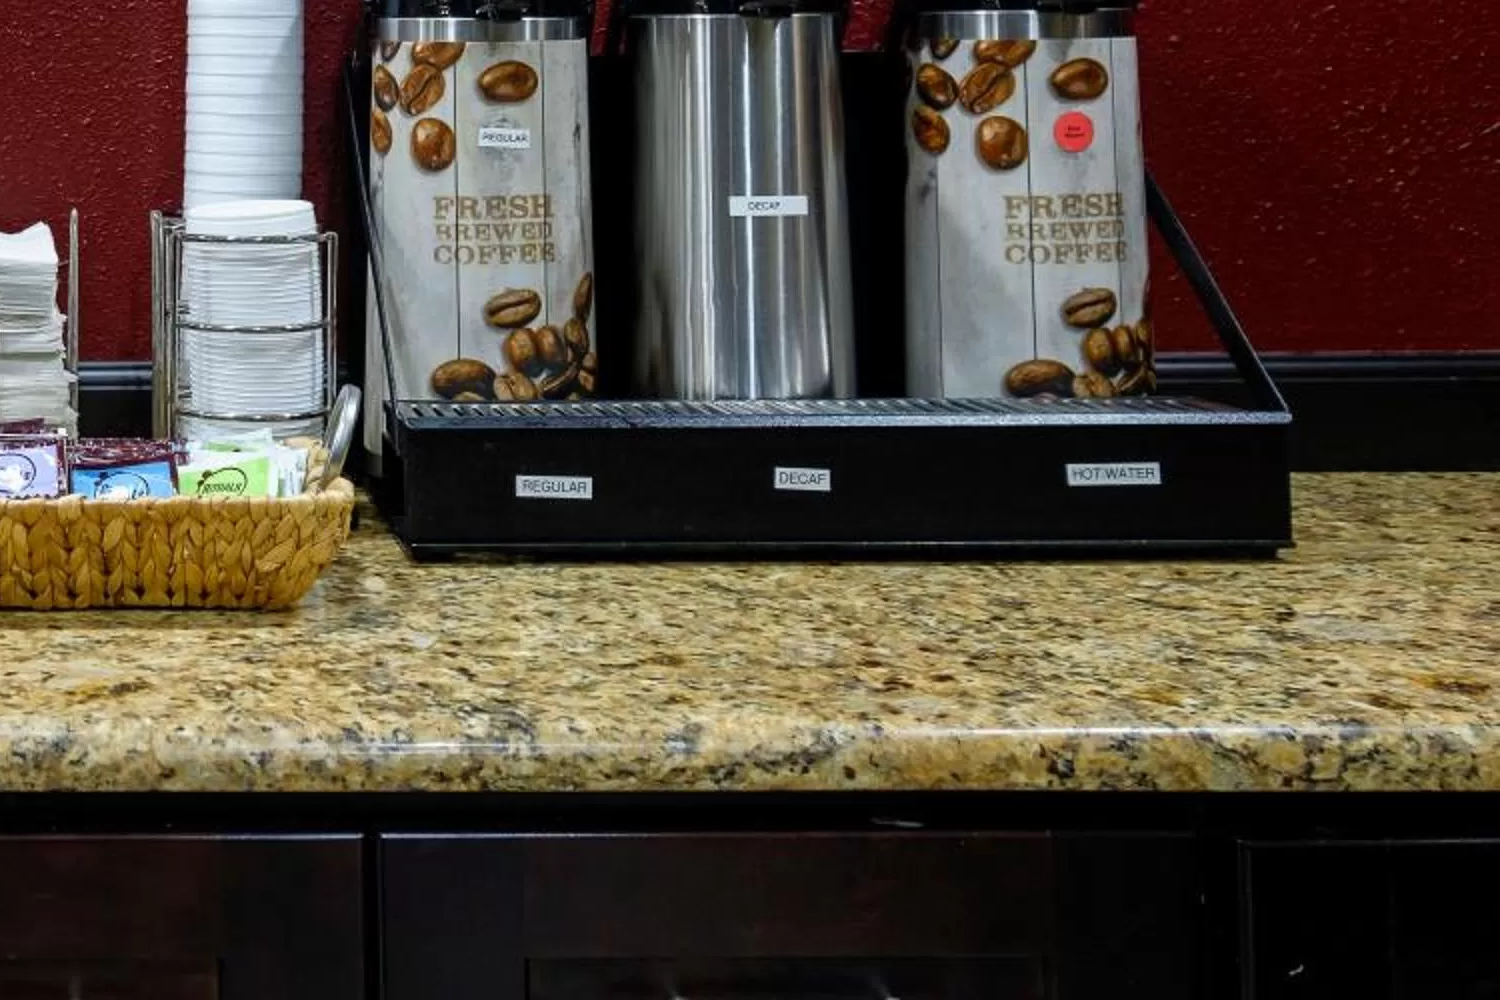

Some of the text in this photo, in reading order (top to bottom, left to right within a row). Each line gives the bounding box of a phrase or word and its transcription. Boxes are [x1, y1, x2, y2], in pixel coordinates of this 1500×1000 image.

[432, 194, 555, 219] FRESH
[747, 201, 781, 211] DECAF
[1002, 193, 1125, 219] FRESH
[434, 221, 553, 241] BREWED
[1005, 220, 1125, 241] BREWED
[433, 243, 556, 265] COFFEE
[1004, 241, 1127, 264] COFFEE
[779, 471, 828, 485] DECAF
[1071, 466, 1155, 480] HOT WATER
[523, 479, 587, 493] REGULAR
